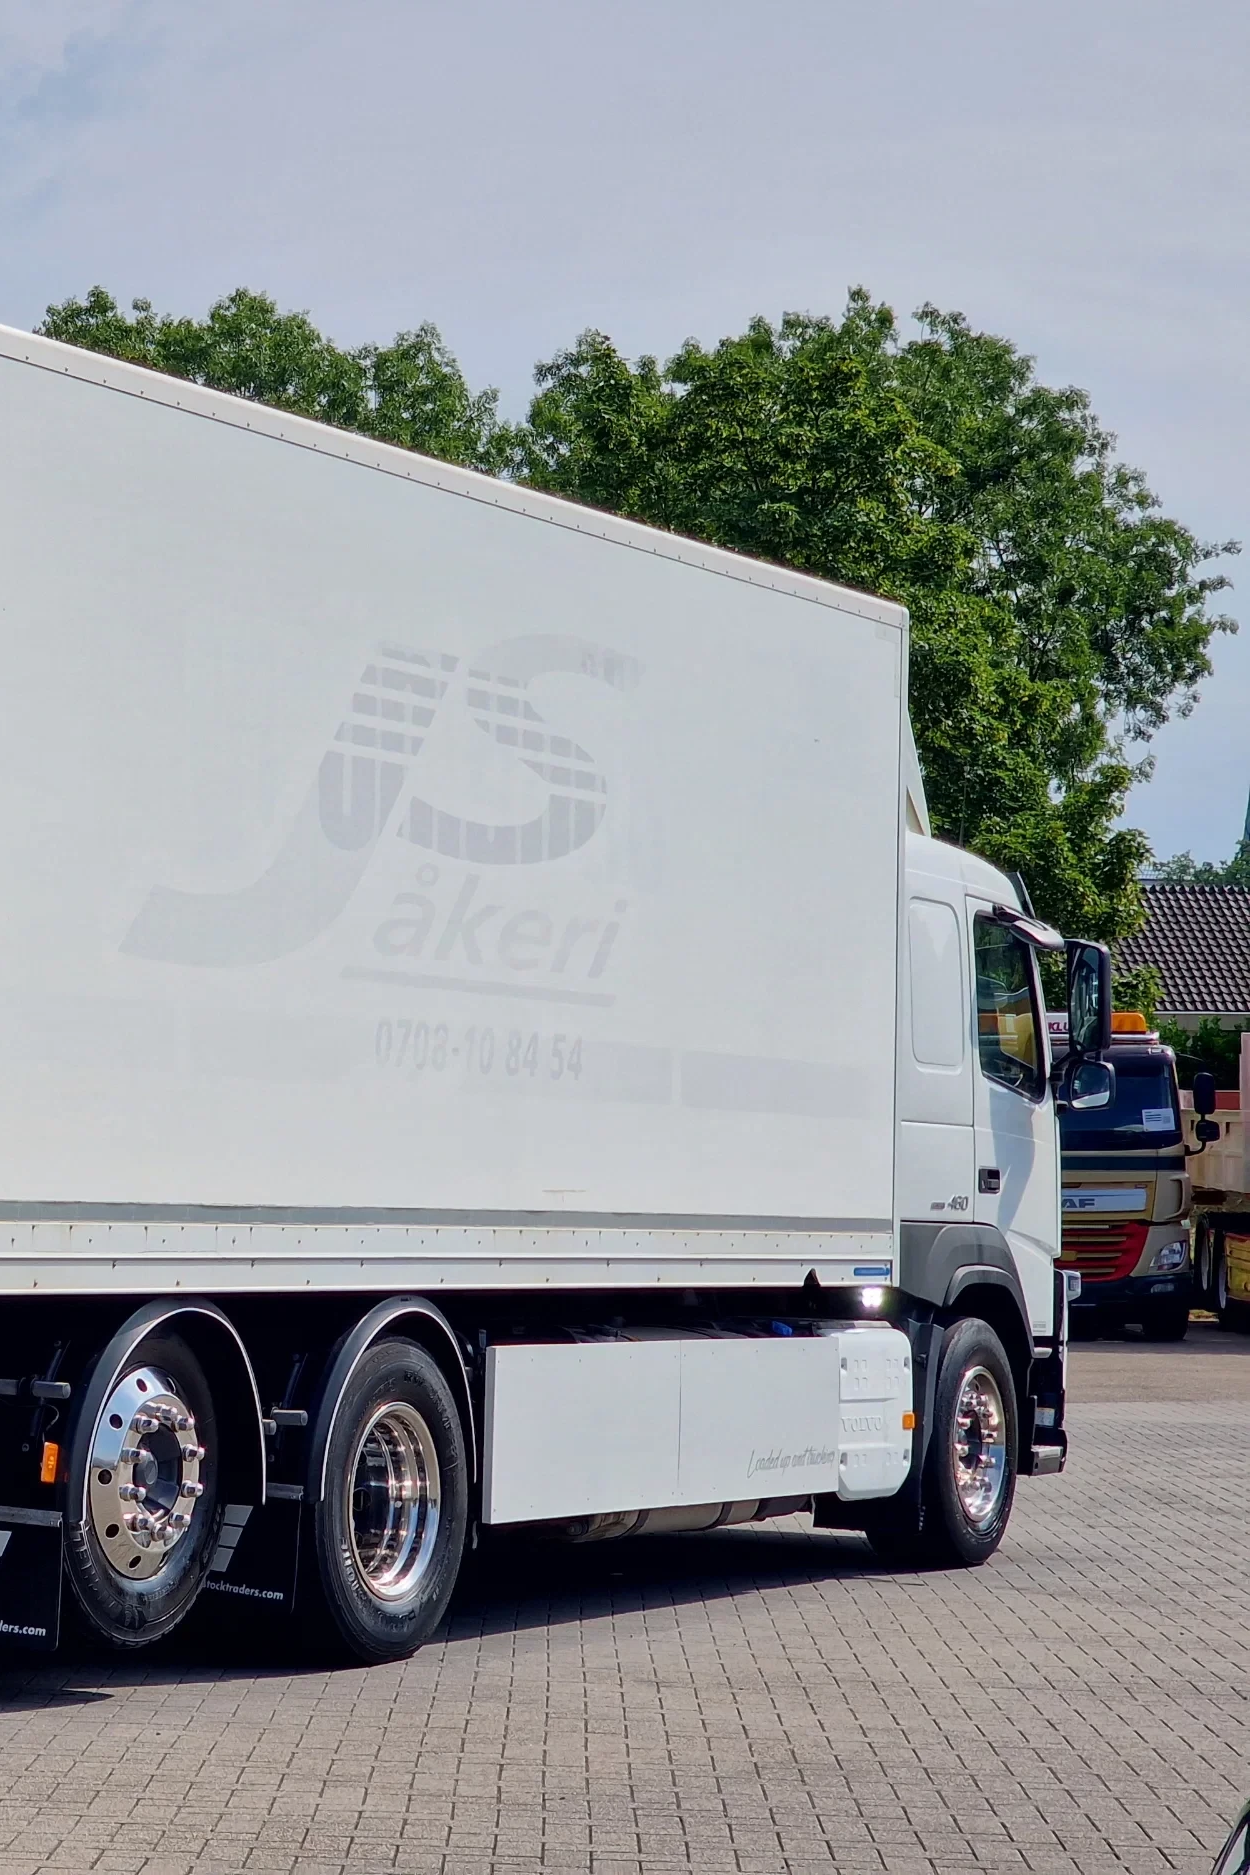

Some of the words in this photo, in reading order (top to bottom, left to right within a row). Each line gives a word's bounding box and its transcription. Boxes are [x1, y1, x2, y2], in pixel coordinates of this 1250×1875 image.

[372, 863, 629, 980] åkeri
[504, 1028, 539, 1078] 84
[549, 1033, 584, 1081] 54
[1061, 1198, 1095, 1209] AF
[840, 1415, 882, 1432] VOLVO
